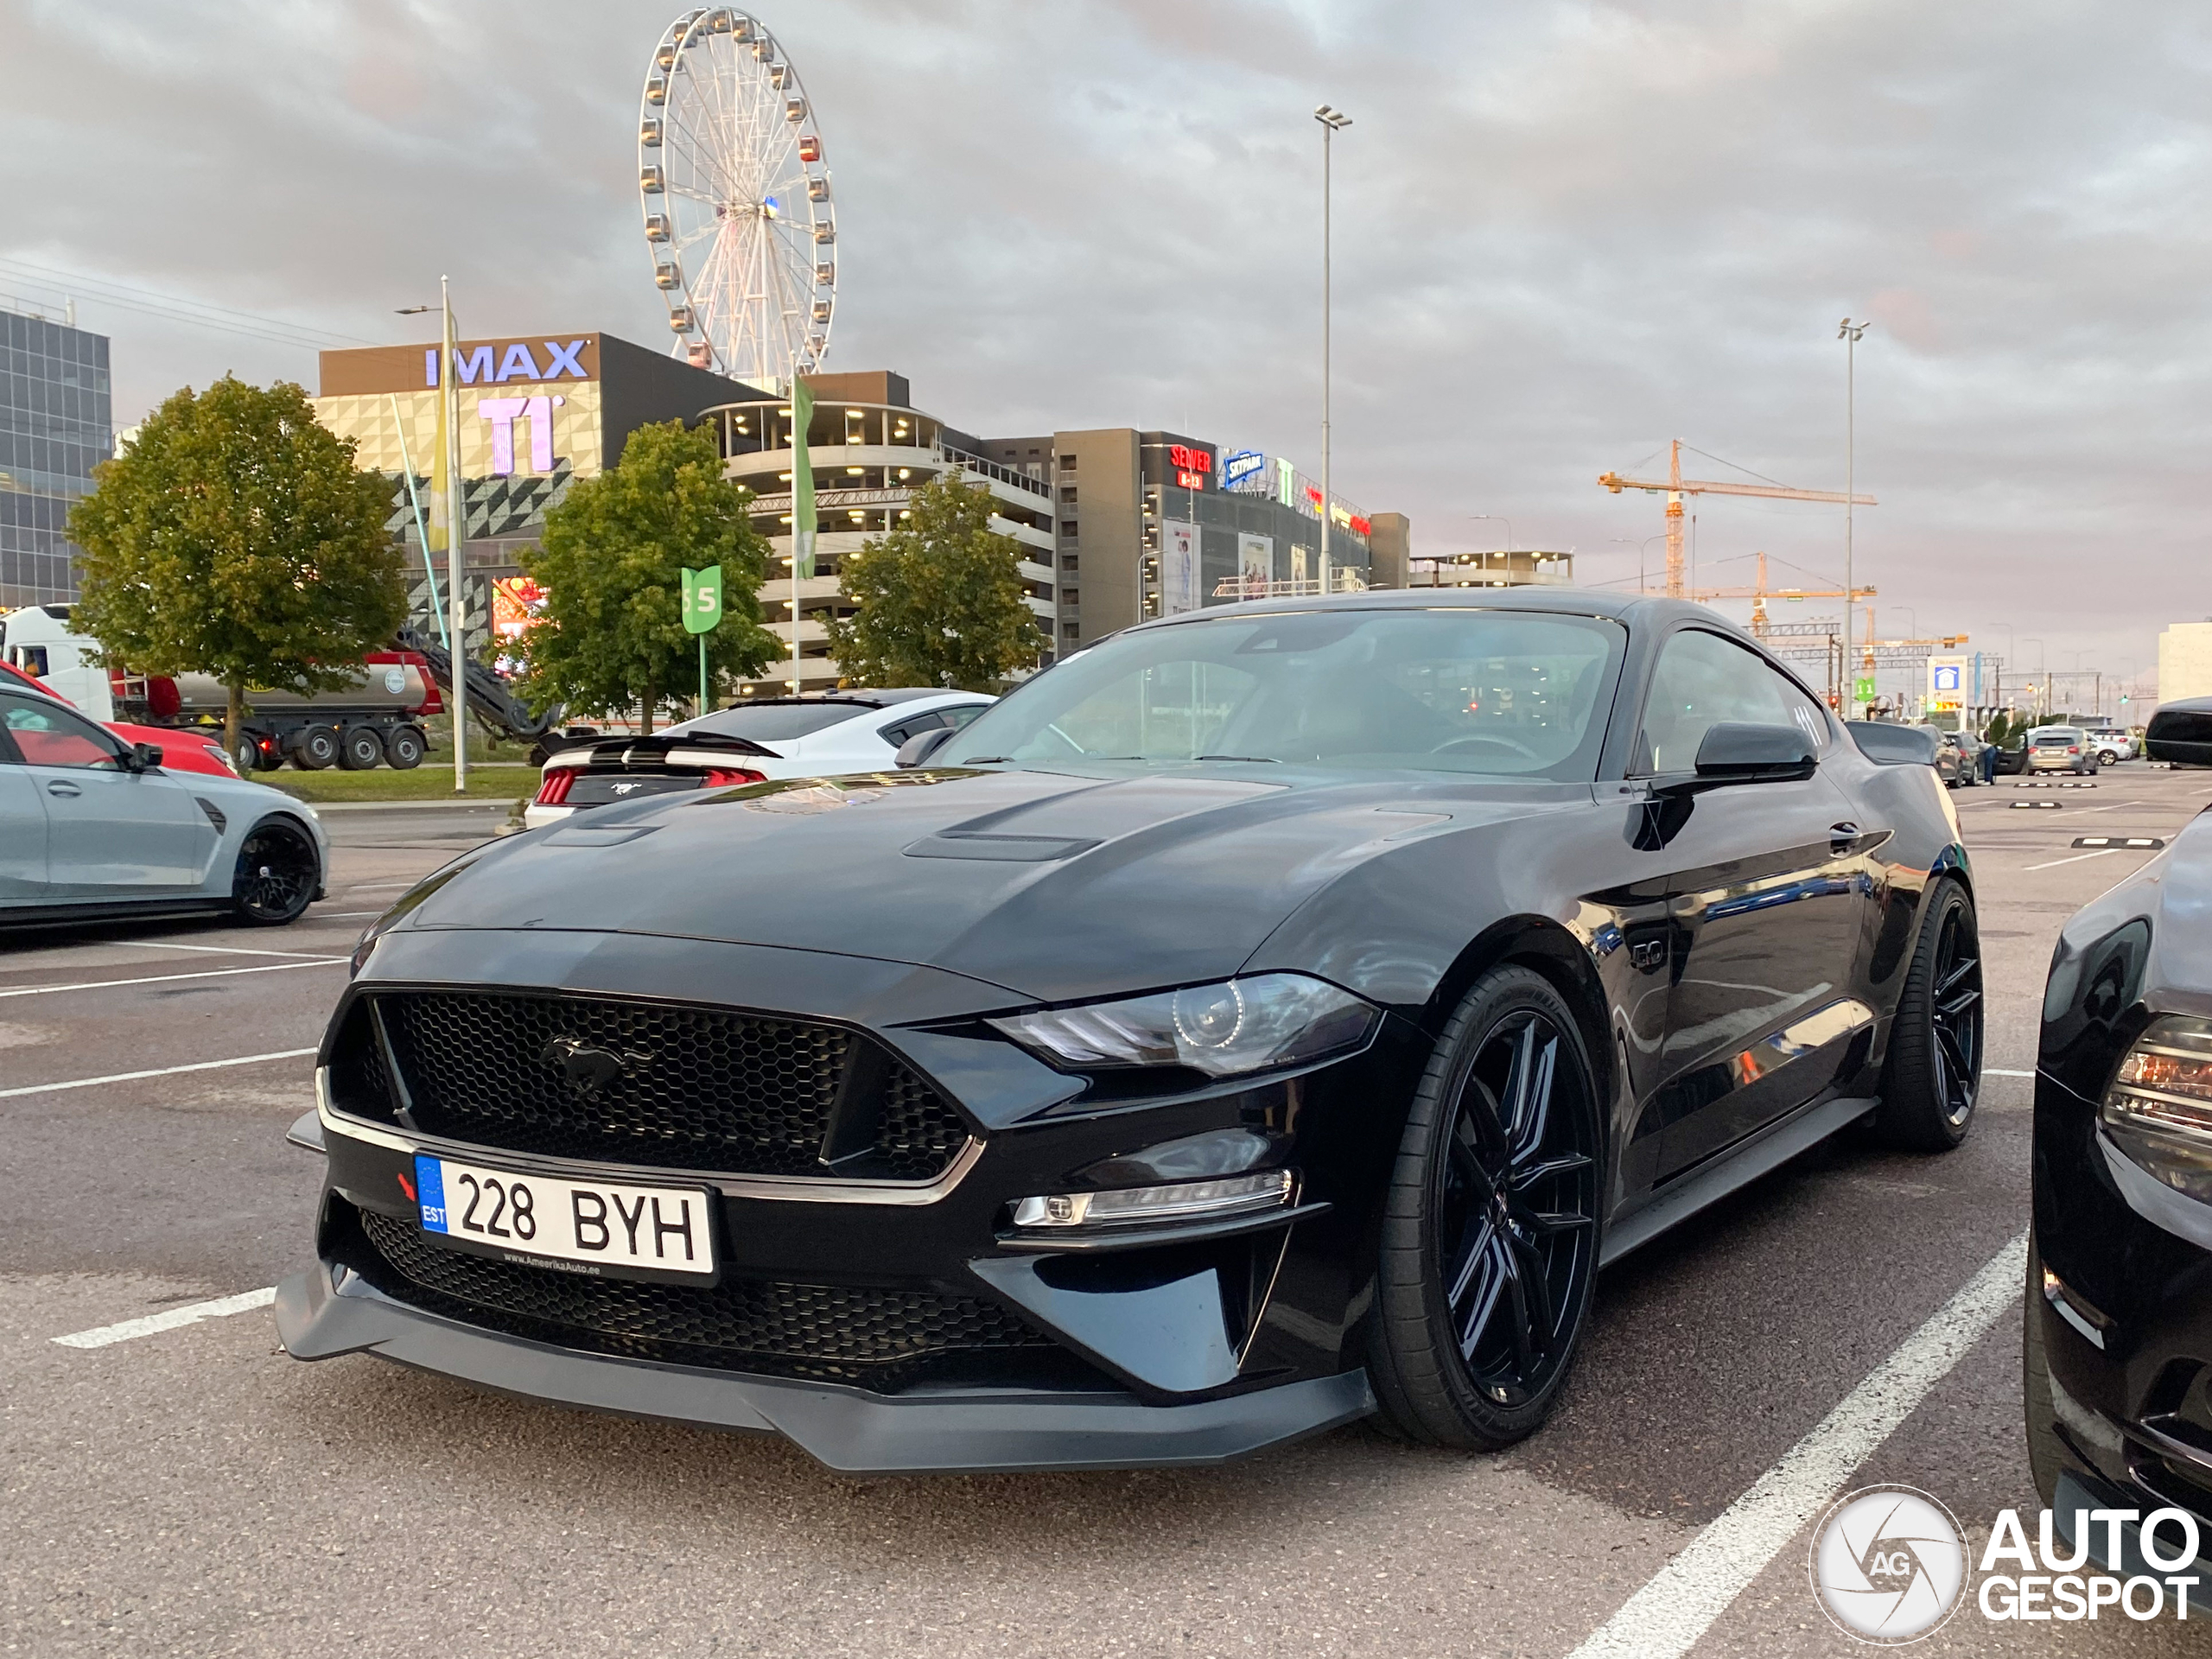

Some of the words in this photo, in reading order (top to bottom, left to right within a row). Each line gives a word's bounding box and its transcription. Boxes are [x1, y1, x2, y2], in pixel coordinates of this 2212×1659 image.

[425, 340, 588, 386] IMAX
[478, 396, 553, 474] T1
[1171, 445, 1211, 473] SELVER
[1229, 455, 1262, 479] SKYPARK
[683, 588, 691, 613] 5
[697, 587, 716, 613] 5
[423, 1205, 446, 1224] EST
[458, 1173, 537, 1241] 228
[570, 1189, 694, 1261] BYH
[504, 1253, 601, 1275] www.AmeerikaAuto.ee
